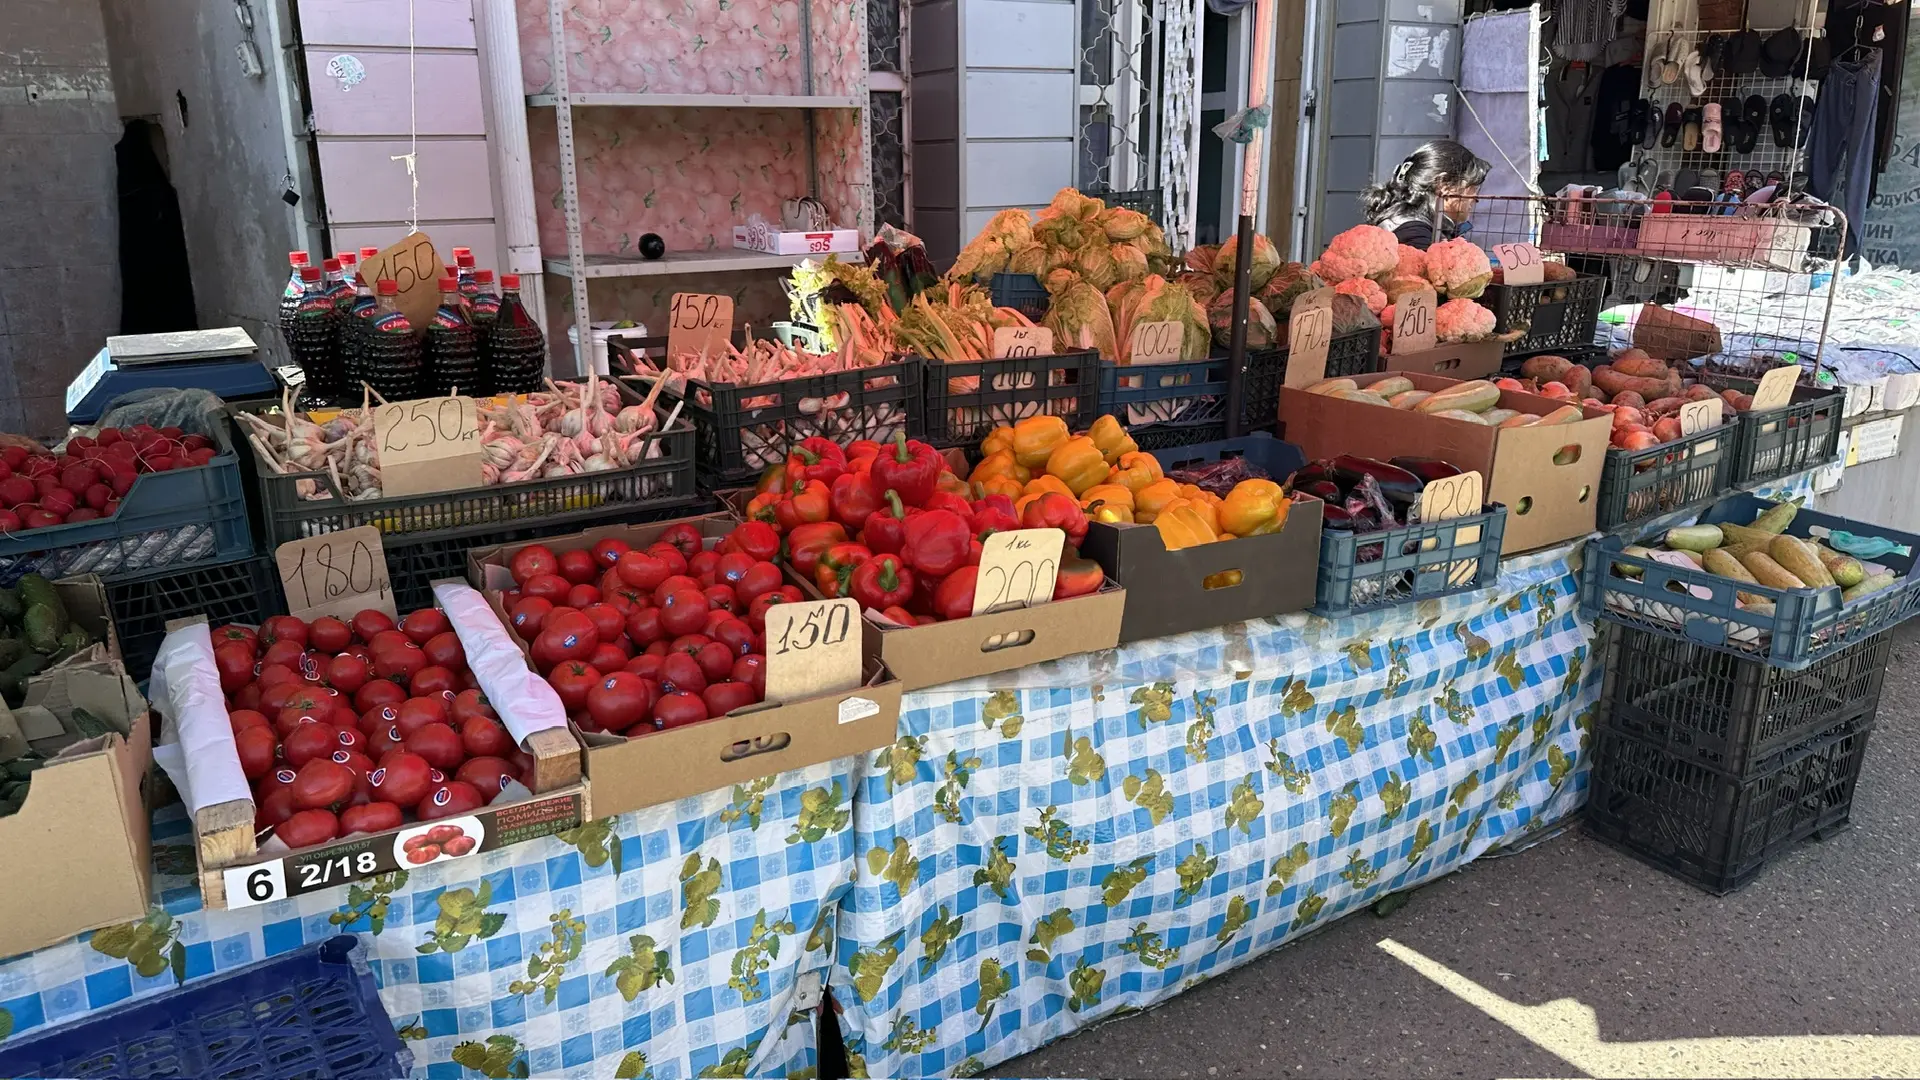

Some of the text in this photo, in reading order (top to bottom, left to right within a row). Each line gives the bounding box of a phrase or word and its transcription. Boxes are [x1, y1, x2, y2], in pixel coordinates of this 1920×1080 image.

[375, 241, 434, 293] 150
[809, 237, 831, 252] SGS
[1500, 243, 1531, 270] 50
[671, 294, 719, 329] 150
[1291, 309, 1325, 355] 170
[1134, 322, 1170, 357] 100
[384, 398, 463, 453] 250
[1683, 404, 1710, 436] 50
[1427, 475, 1474, 522] 120
[284, 540, 374, 608] 180
[983, 558, 1055, 614] 200
[775, 603, 850, 655] 150
[496, 796, 573, 817] ВСЕГДА СВЕЖИЕ
[496, 803, 574, 825] ПОМИДОРЫ
[246, 851, 377, 901] 6 2/18
